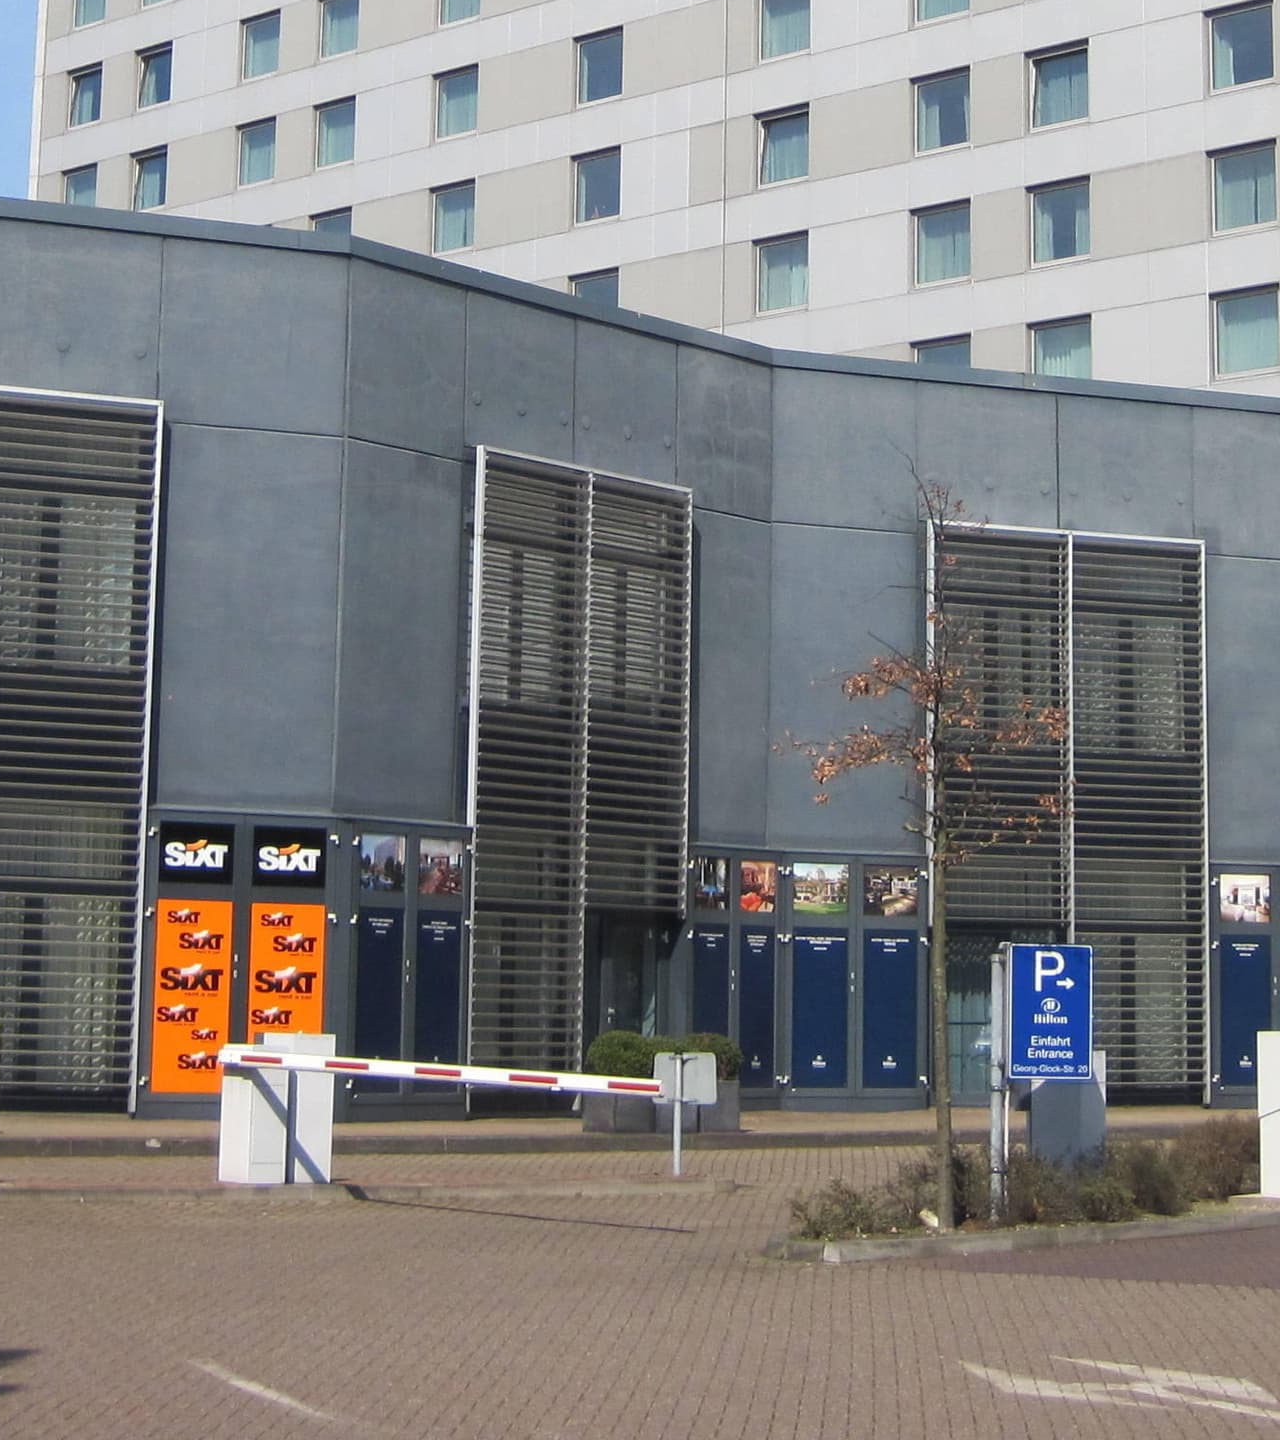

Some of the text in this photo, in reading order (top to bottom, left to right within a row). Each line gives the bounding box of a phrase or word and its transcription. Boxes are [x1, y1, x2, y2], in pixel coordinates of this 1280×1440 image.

[1035, 951, 1064, 992] P
[1034, 1013, 1068, 1024] Hilton
[1031, 1035, 1071, 1047] Einfahrt
[1027, 1047, 1074, 1059] Entrance
